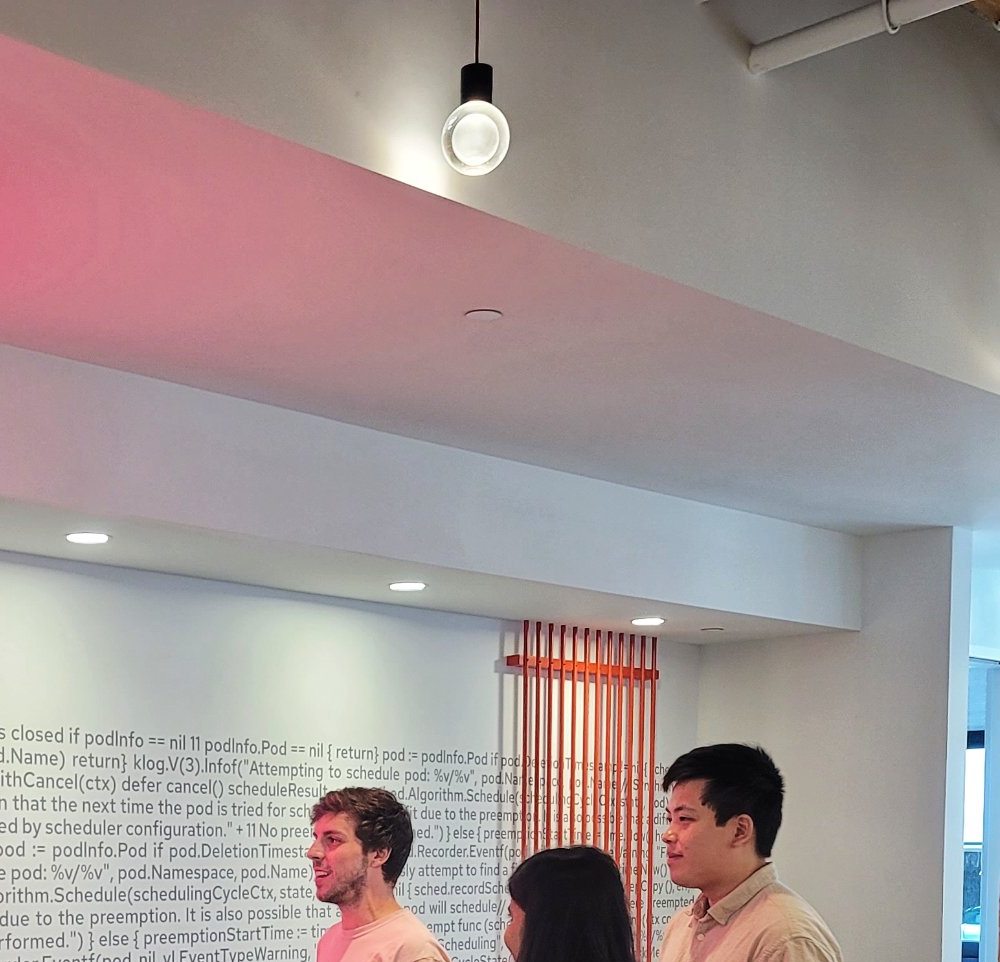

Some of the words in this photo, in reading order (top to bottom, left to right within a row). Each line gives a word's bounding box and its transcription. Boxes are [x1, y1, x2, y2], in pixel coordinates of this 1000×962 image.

[11, 724, 63, 743] closed
[69, 727, 80, 744] if
[170, 734, 186, 751] nil
[309, 743, 323, 758] nil
[382, 747, 405, 765] pod
[73, 752, 127, 774] return}
[328, 765, 341, 778] to
[346, 765, 400, 780] schedule
[122, 775, 162, 793] defer
[166, 779, 224, 799] cancel()
[12, 794, 47, 811] that
[51, 795, 77, 813] the
[82, 798, 116, 813] next
[120, 797, 154, 814] time
[158, 799, 182, 816] the
[186, 801, 215, 819] pod
[217, 802, 228, 816] is
[230, 802, 263, 817] tried
[267, 801, 287, 818] for
[421, 806, 442, 820] due
[444, 808, 456, 820] to
[459, 807, 477, 821] the
[22, 817, 42, 839] by
[45, 818, 124, 838] scheduler
[259, 823, 278, 838] No
[281, 826, 312, 842] pree
[453, 825, 475, 839] else
[53, 842, 147, 862] podInfo.Pod
[153, 841, 164, 858] if
[11, 863, 47, 885] pod:
[118, 864, 238, 885] pod.Namespace,
[241, 863, 313, 884] pod.Name)
[418, 863, 465, 881] attempt
[465, 864, 478, 877] to
[479, 862, 500, 877] find
[0, 909, 30, 928] due
[35, 910, 52, 926] to
[58, 908, 84, 925] the
[90, 906, 181, 929] preemption.
[201, 906, 211, 922] is
[216, 905, 243, 922] also
[248, 902, 301, 925] possible
[305, 904, 331, 919] that
[429, 899, 447, 915] will
[99, 930, 129, 948] else
[143, 925, 294, 949] preemptionStartTime
[458, 918, 483, 931] func
